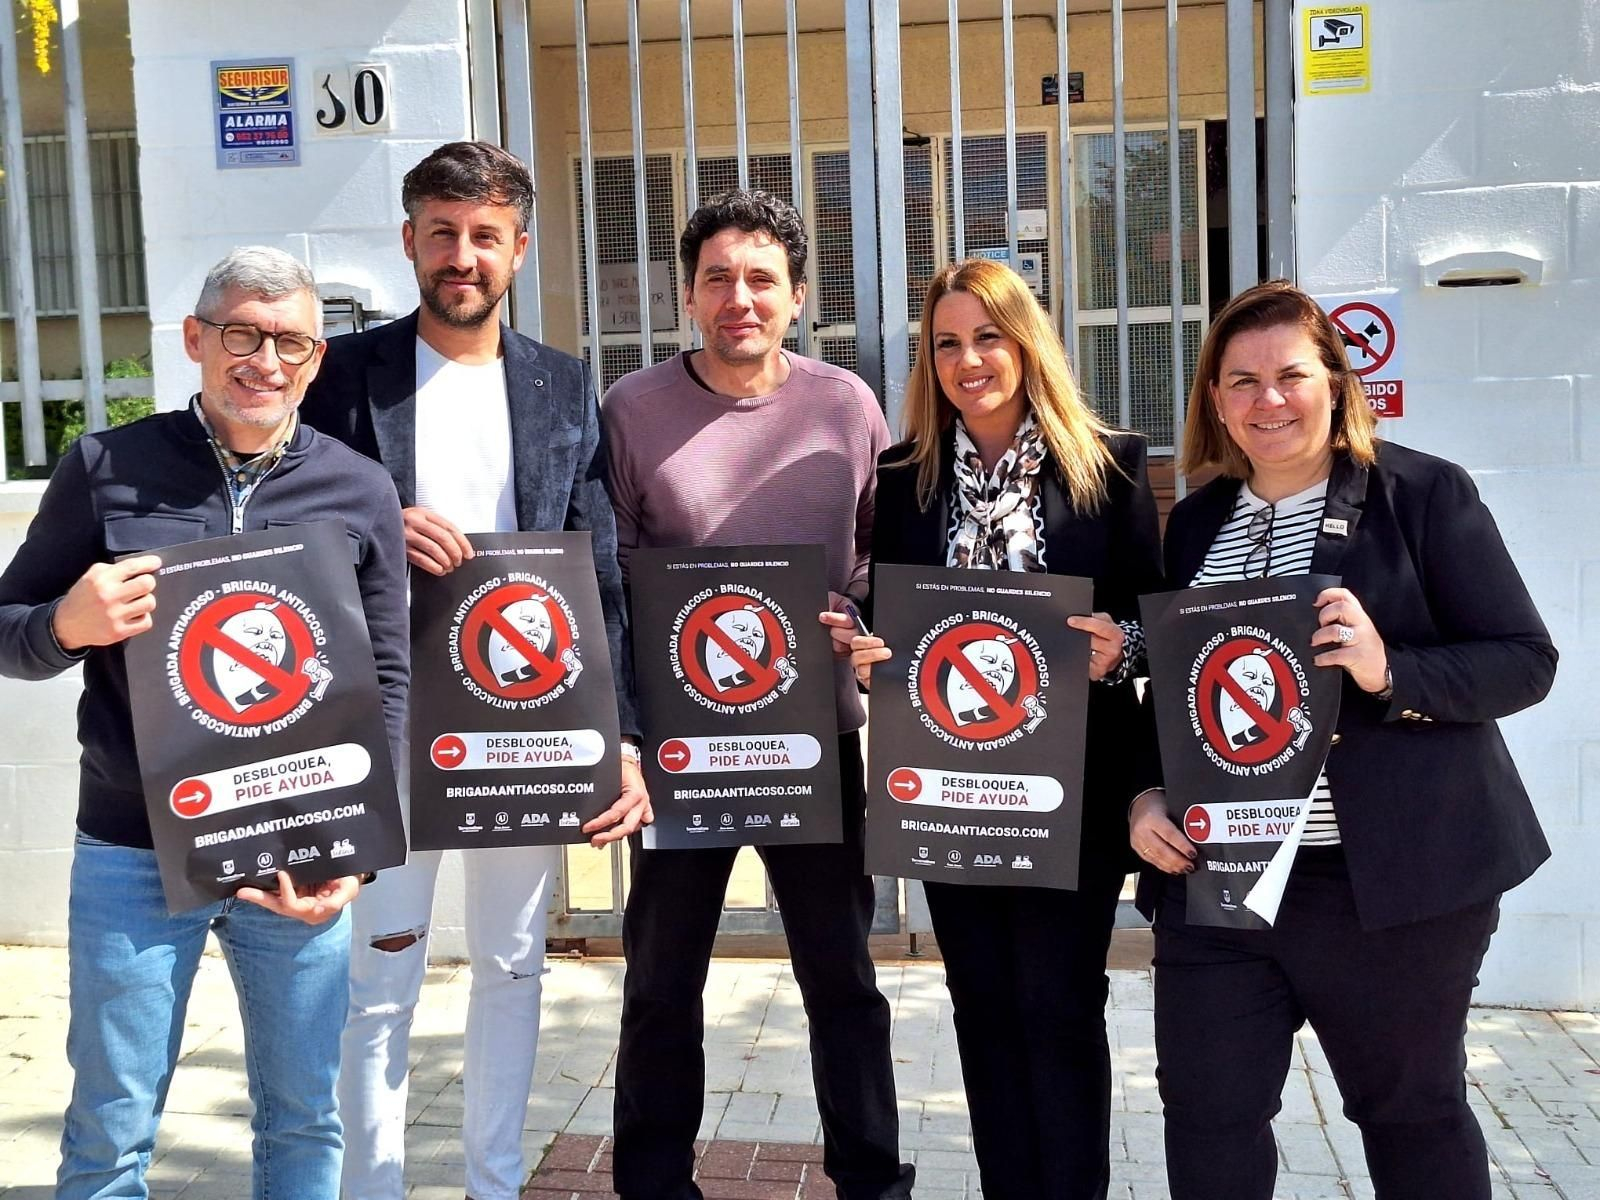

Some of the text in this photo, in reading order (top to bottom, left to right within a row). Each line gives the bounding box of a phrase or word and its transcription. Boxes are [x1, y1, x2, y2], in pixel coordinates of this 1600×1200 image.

[220, 70, 288, 87] SEGURISUR
[226, 114, 288, 128] ALARMA
[222, 580, 326, 646] BRIGADA ANTIACOSO
[508, 572, 579, 639] BRIGADA ANTIACOSO
[720, 584, 797, 649] BRIGADA ANTIACOSO
[449, 577, 500, 672] BRIGADA ANTIACOSO
[669, 588, 713, 680] BRIGADA ANTIACOSO
[166, 590, 215, 706] BRIGADA ANTIACOSO
[908, 613, 964, 708] BRIGADA ANTIACOSO
[972, 610, 1049, 687] BRIGADA ANTIACOSO
[1230, 625, 1310, 697] BRIGADA ANTIACOSO
[462, 677, 566, 710] BRIGADA ANTIACOSO
[1188, 632, 1225, 736] BRIGADA ANTIACOSO
[683, 684, 779, 715] BRIGADA ANTIACOSO
[191, 700, 313, 738] BRIGADA ANTIACOSO
[920, 714, 1024, 751] BRIGADA ANTIACOSO
[486, 737, 573, 749] DESBLOQUEA,
[487, 750, 573, 763] PIDE AYUDA
[708, 740, 789, 752] DESBLOQUEA,
[234, 756, 331, 785] DESBLOQUEA,
[710, 754, 790, 766] PIDE AYUDA
[1202, 742, 1295, 777] BRIGADA ANTIACOSO
[235, 770, 335, 801] PIDE AYUDA
[446, 783, 594, 798] BRIGADAANTIACOSO.COM
[674, 786, 812, 799] BRIGADAANTIACOSO.COM
[942, 777, 1028, 793] DESBLOQUEA,
[942, 790, 1028, 806] PIDE AYUDA
[195, 803, 365, 848] BRIGADAANTIACOSO.COM
[521, 813, 550, 824] ADA
[745, 814, 772, 824] ADA
[901, 819, 1049, 838] BRIGADAANTIACOSO.COM
[1228, 822, 1294, 837] PIDE AYU
[288, 846, 320, 862] ADA
[974, 854, 1003, 864] ADA
[1207, 860, 1270, 873] BRIGADAANT
